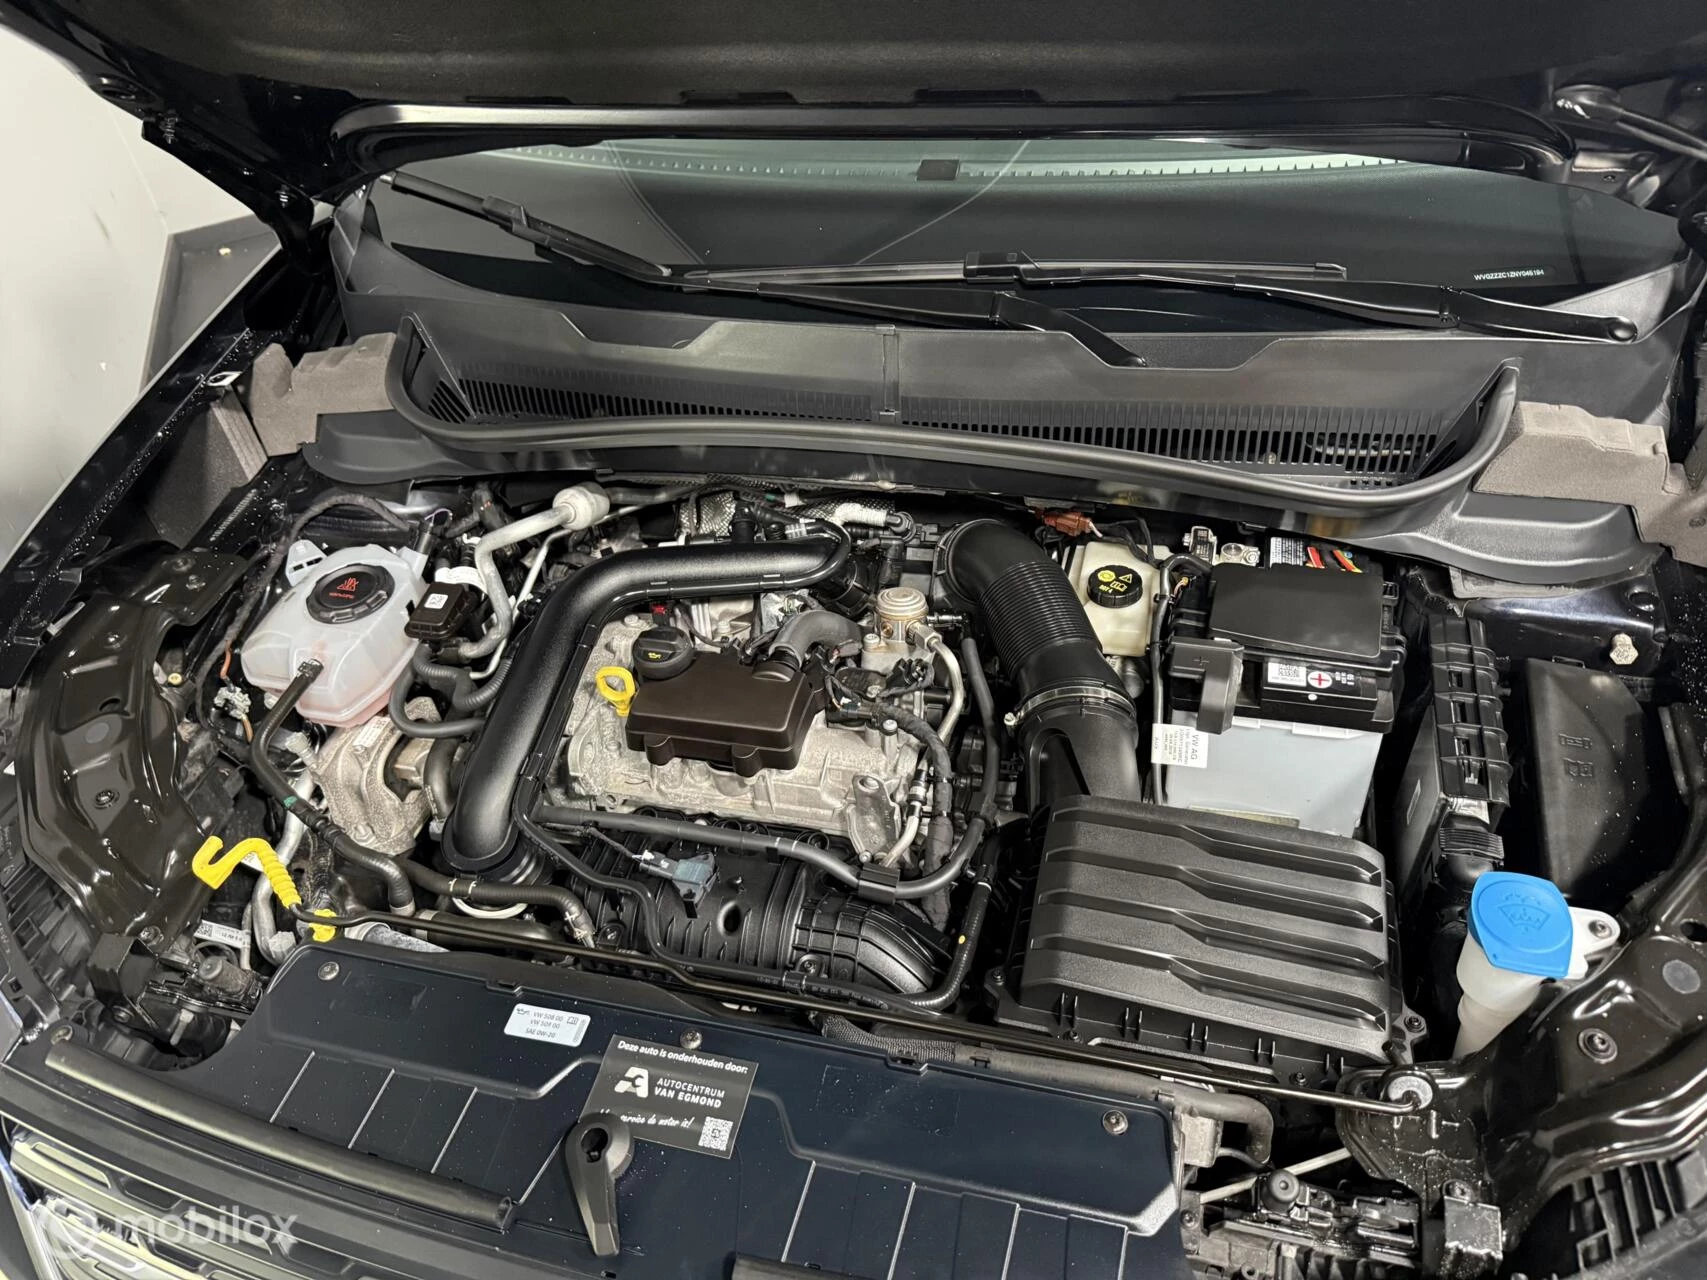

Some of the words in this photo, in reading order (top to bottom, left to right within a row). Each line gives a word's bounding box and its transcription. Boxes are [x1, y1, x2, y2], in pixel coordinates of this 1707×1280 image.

[533, 1011, 544, 1019] VW
[525, 1027, 536, 1036] SAE
[551, 1022, 561, 1030] 00
[617, 1040, 639, 1053] Deze
[639, 1045, 659, 1057] auto
[659, 1048, 667, 1058] is
[667, 1052, 724, 1069] onderhouden
[724, 1062, 749, 1074] door:
[656, 1077, 725, 1099] AUTOCENTRUM
[654, 1087, 675, 1099] VAN
[677, 1092, 722, 1109] EGMOND
